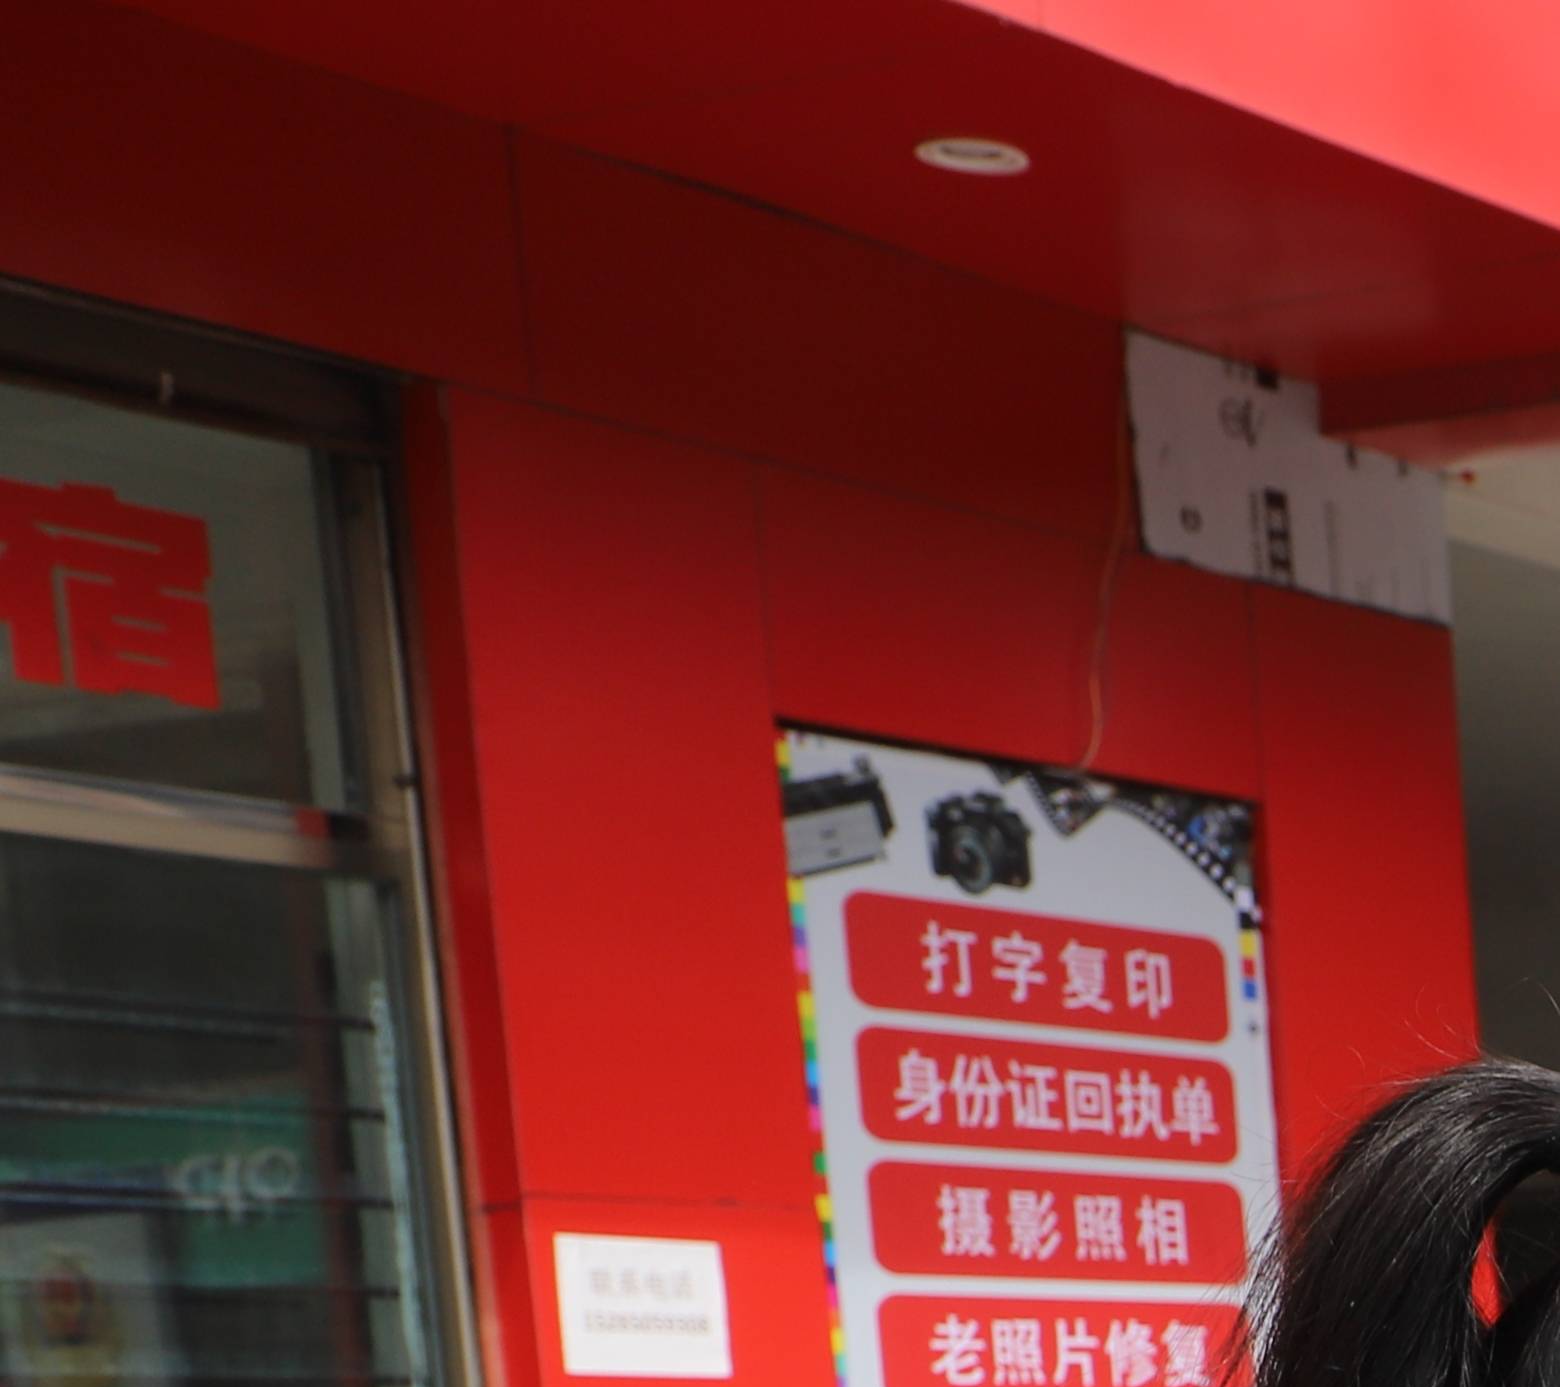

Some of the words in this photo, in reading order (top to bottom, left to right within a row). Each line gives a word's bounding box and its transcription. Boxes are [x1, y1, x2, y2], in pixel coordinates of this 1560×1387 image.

[919, 920, 1175, 1021] 打字复印
[893, 1047, 1221, 1148] 身份证回执单
[937, 1184, 1191, 1266] 摄影照相
